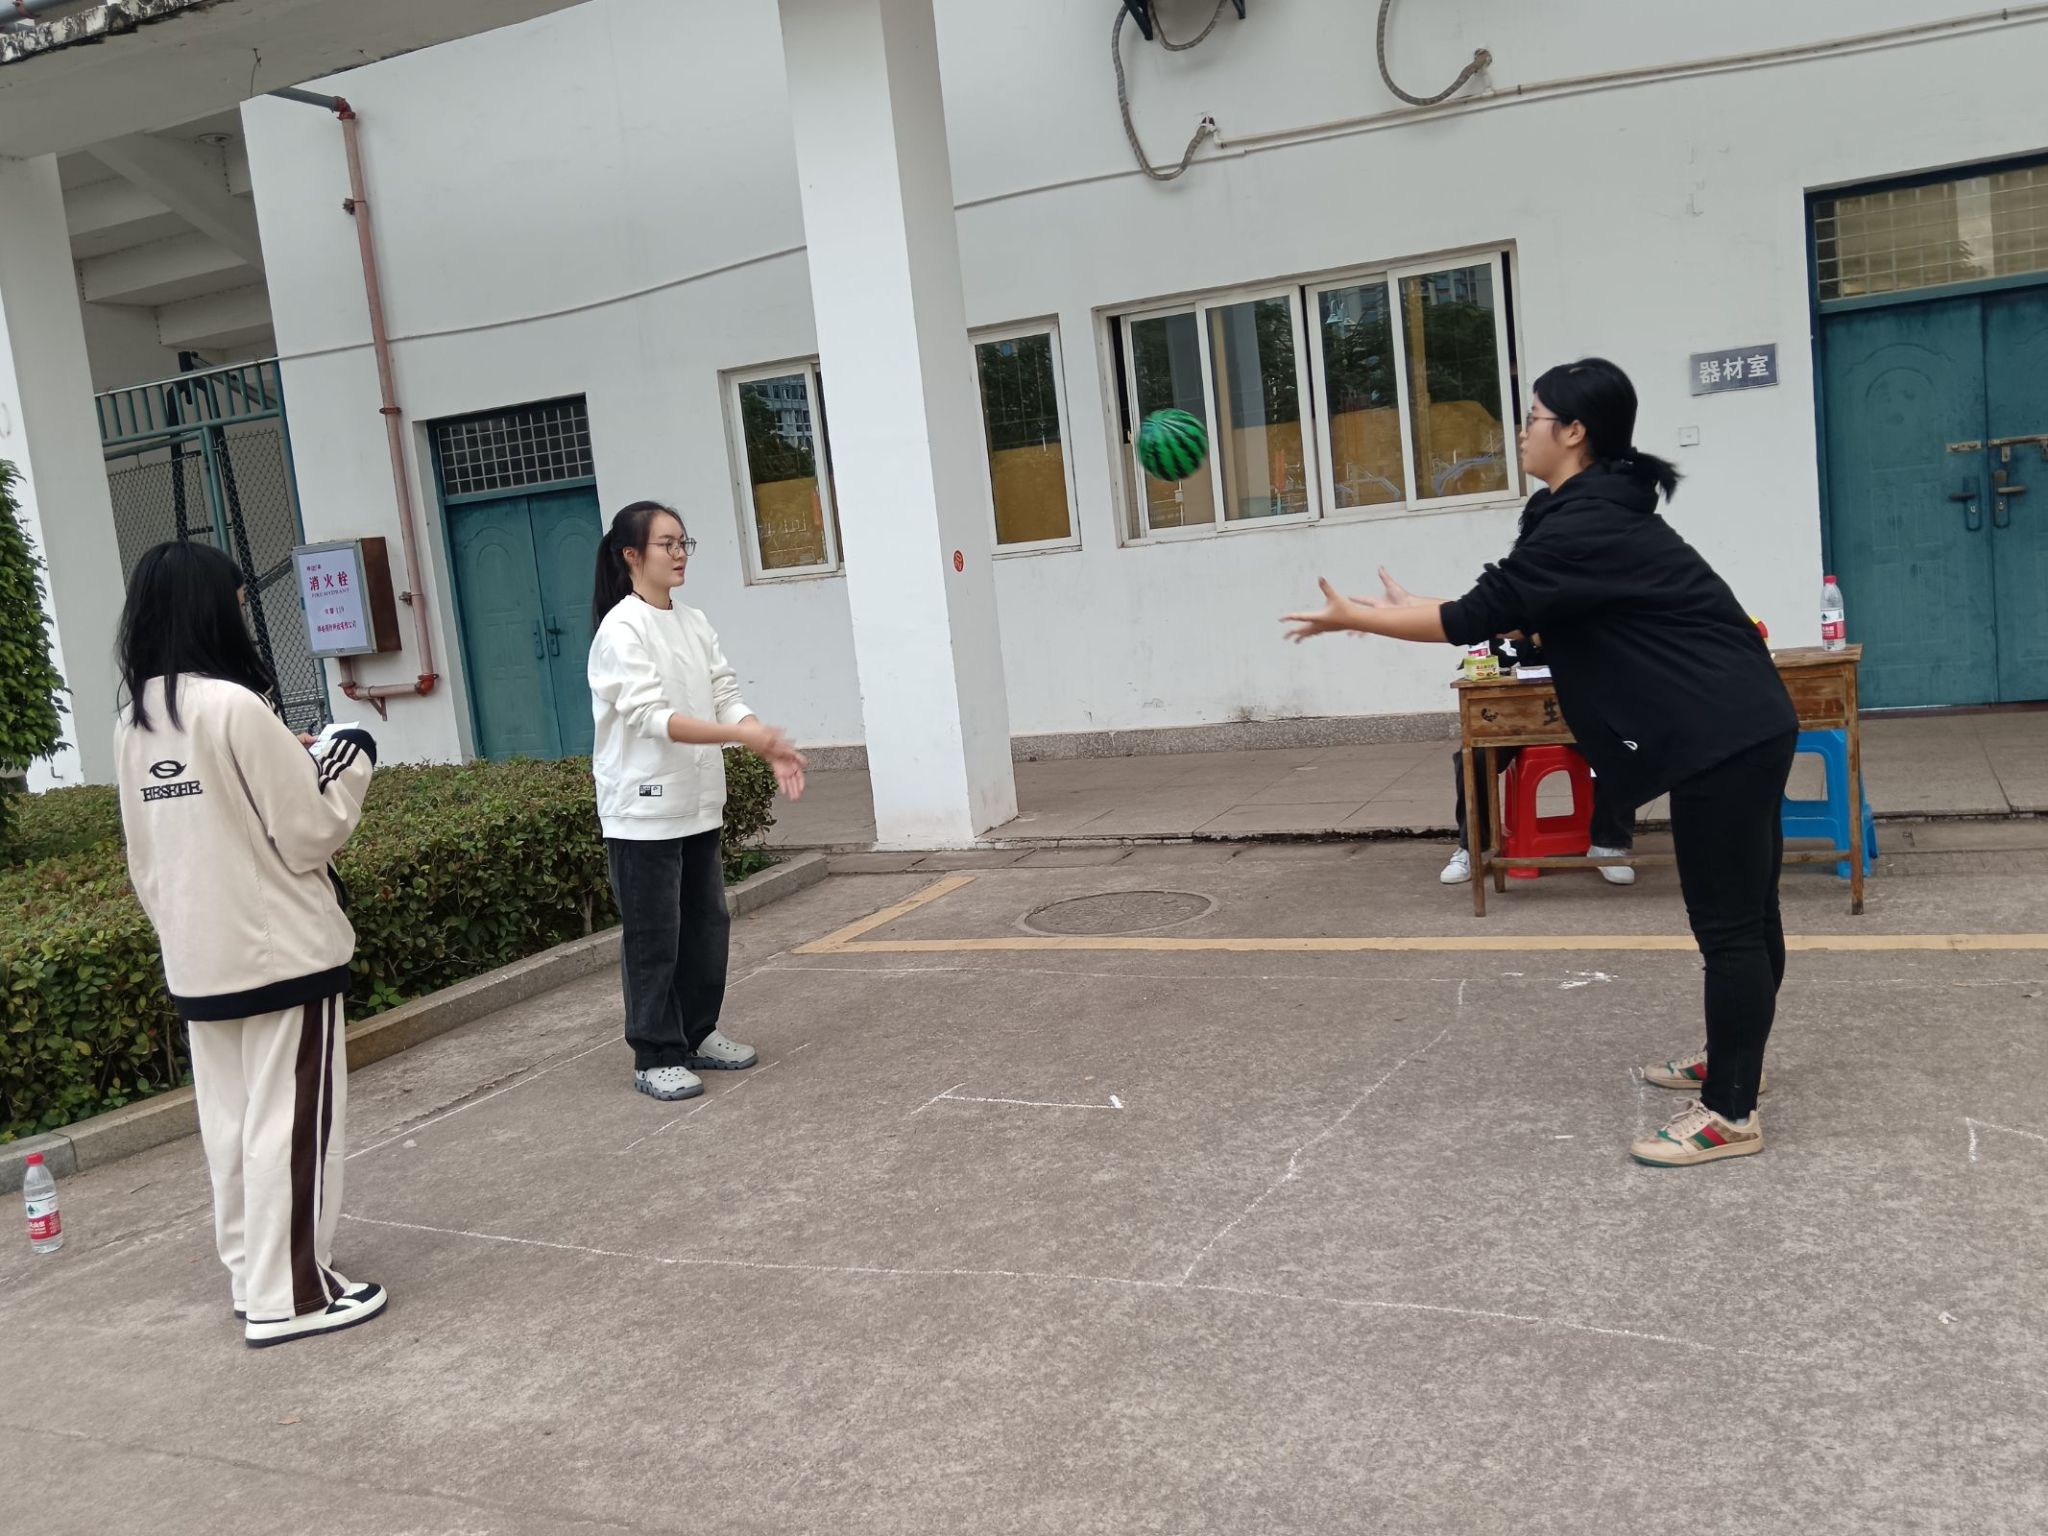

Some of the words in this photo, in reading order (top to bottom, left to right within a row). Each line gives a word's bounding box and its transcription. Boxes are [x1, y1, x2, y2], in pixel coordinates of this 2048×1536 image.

[1699, 354, 1769, 384] 器材室
[309, 571, 349, 591] 消火栓
